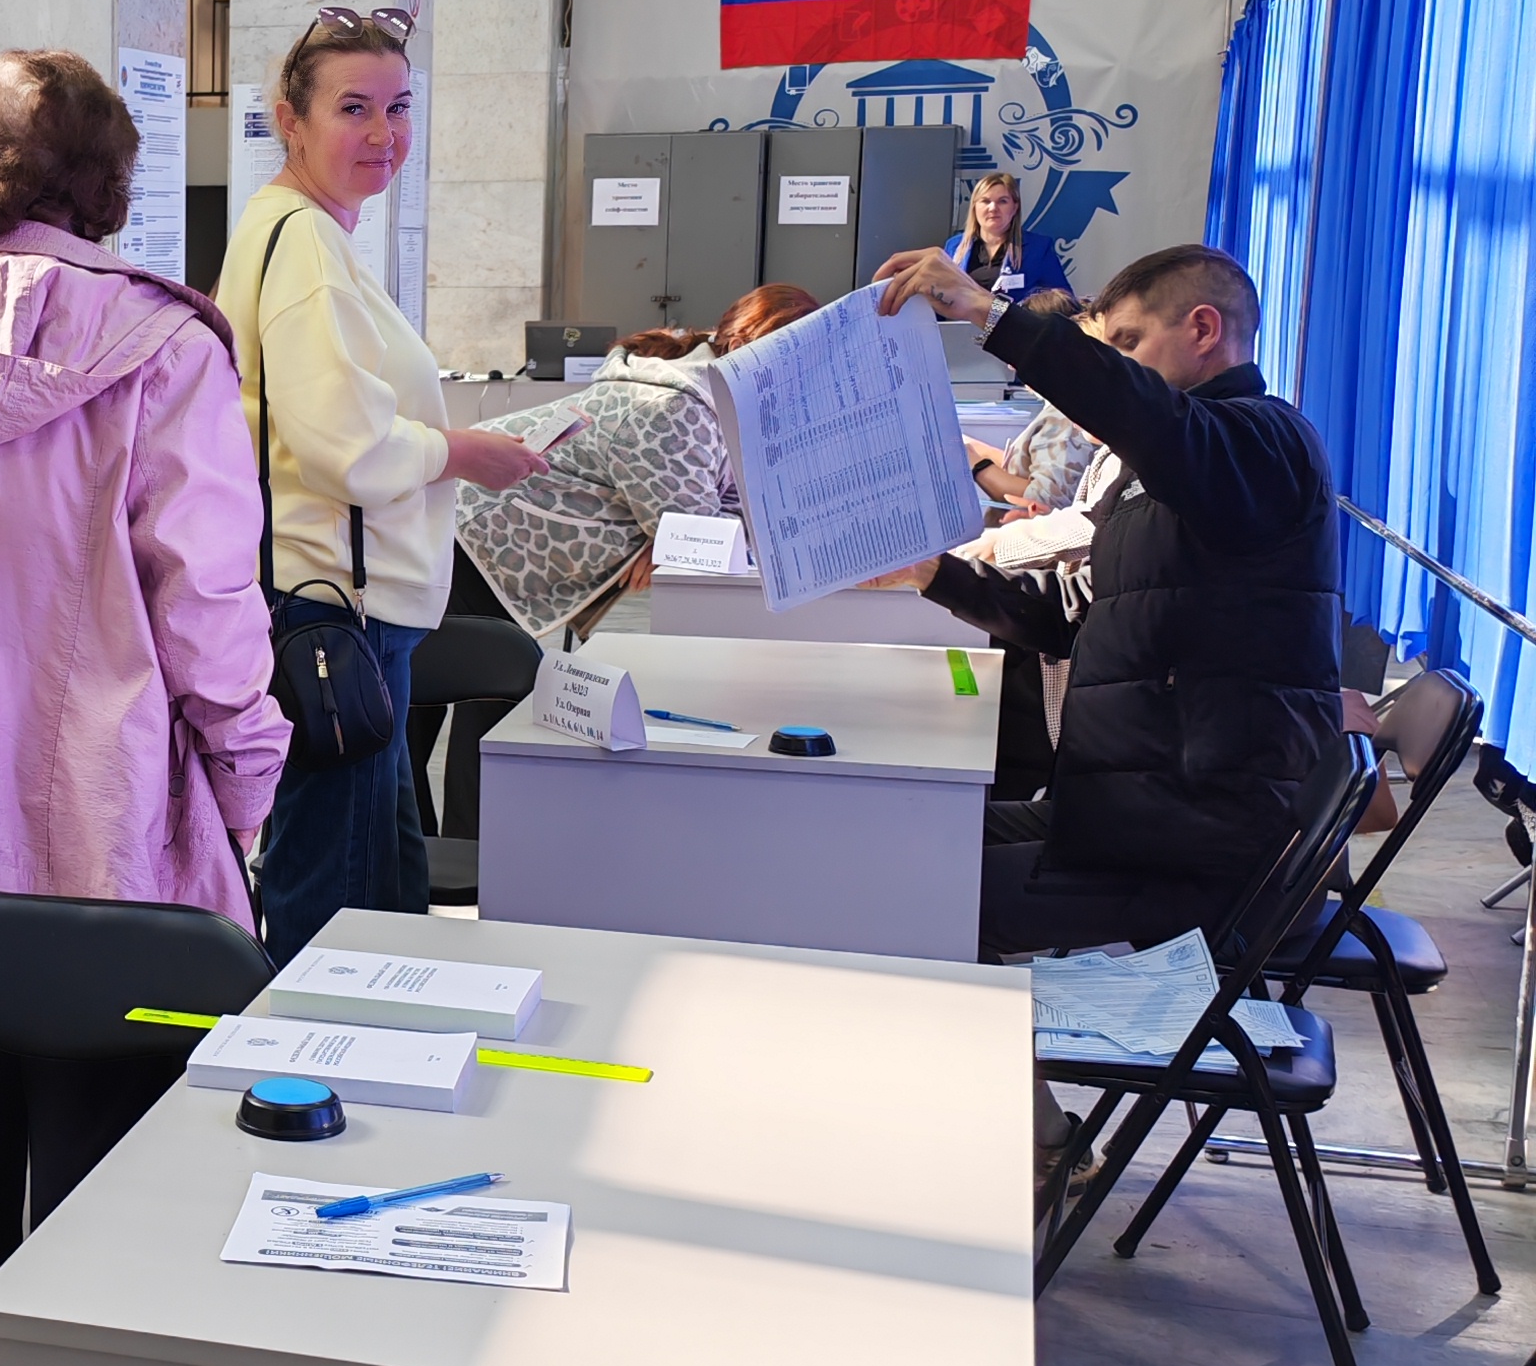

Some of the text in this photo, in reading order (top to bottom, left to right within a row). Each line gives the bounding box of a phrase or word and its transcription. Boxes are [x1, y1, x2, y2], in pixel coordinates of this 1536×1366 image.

[265, 1249, 520, 1277] ВНИМАНИЕ! ТЕЛЕФОННЫЕ МОШЕННИКИ!
